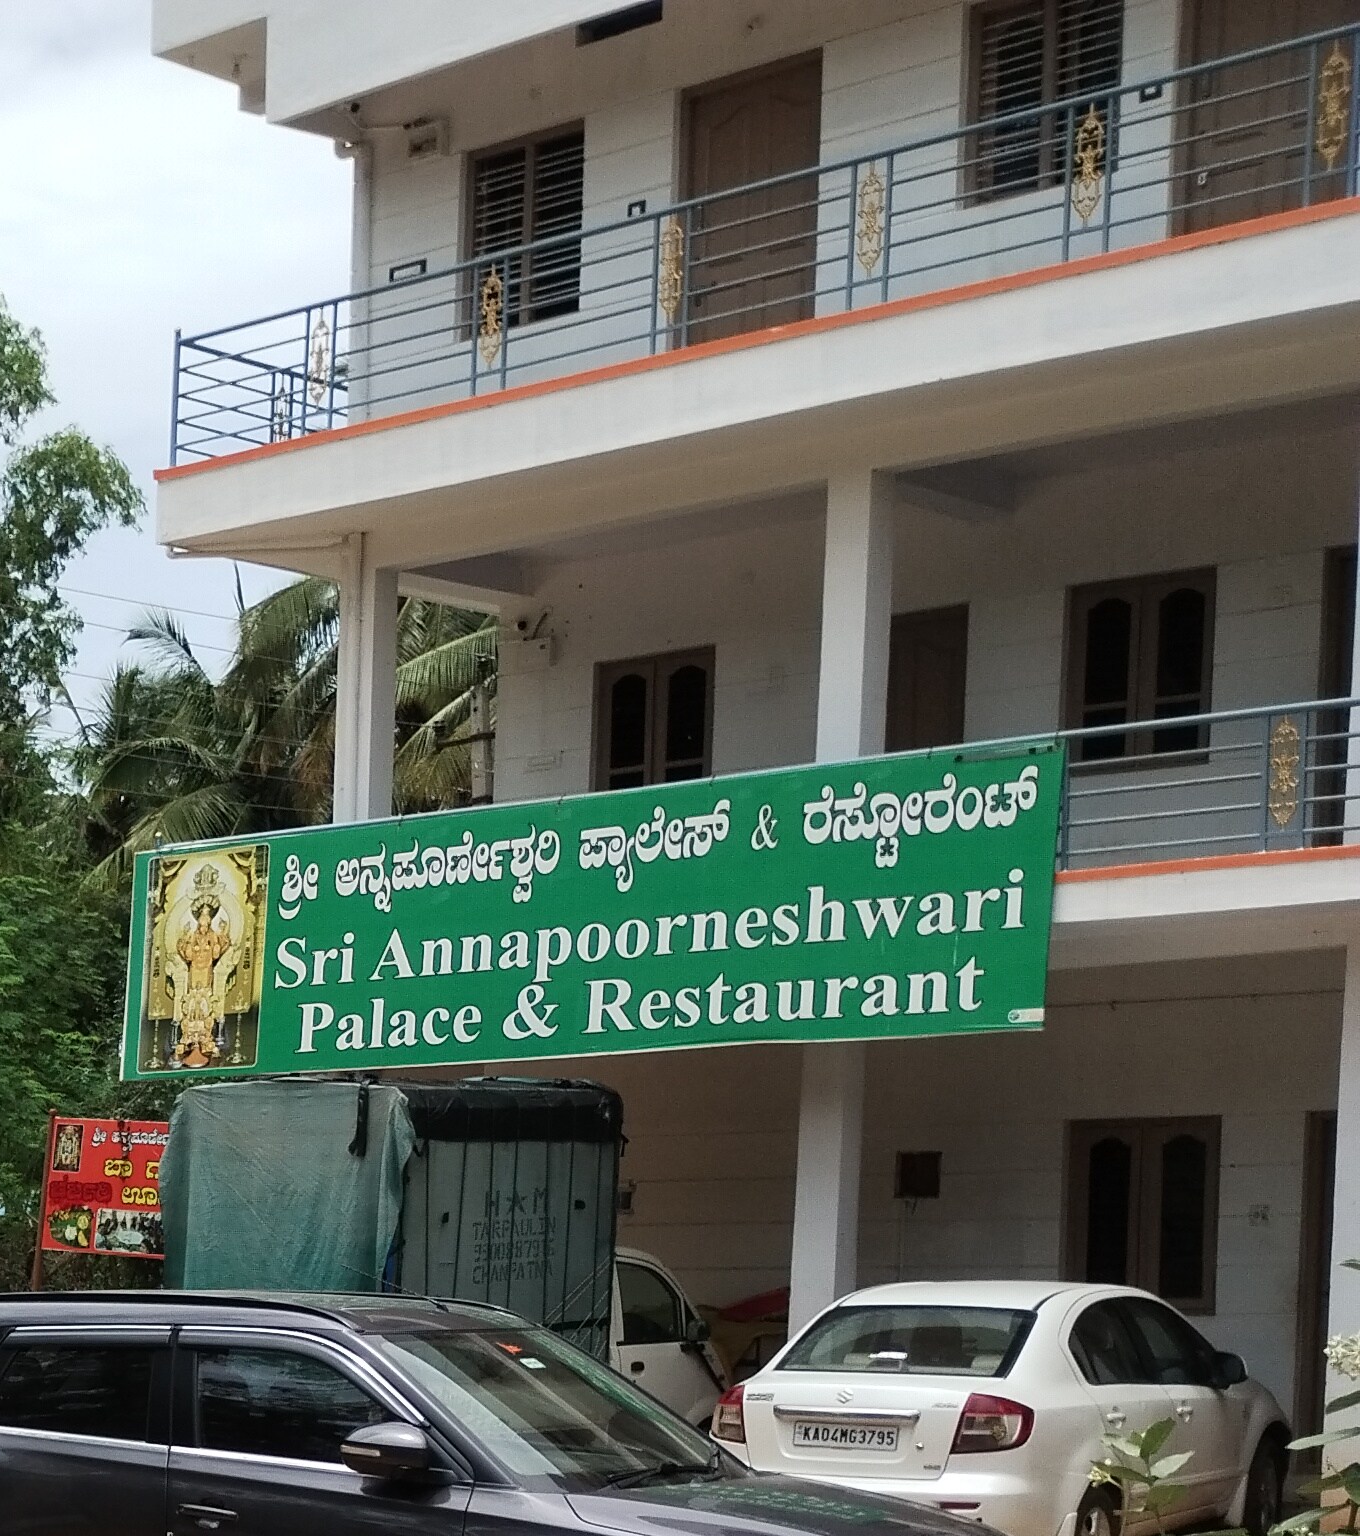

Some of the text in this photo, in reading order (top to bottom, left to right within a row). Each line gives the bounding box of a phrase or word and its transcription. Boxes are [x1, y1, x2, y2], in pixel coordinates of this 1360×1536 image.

[278, 764, 1039, 920] ಶ್ರೀ ಅನ್ನಪೂರ್ಣೇಶ್ವರಿ ಪ್ಯಾಲೇಸ್ & ರೆಸ್ಟೋರೆಂಟ್
[274, 867, 1026, 990] Sri Annapoorneshwari
[293, 955, 985, 1054] Palace & Restaurant
[802, 1425, 896, 1446] KA04MG3795
